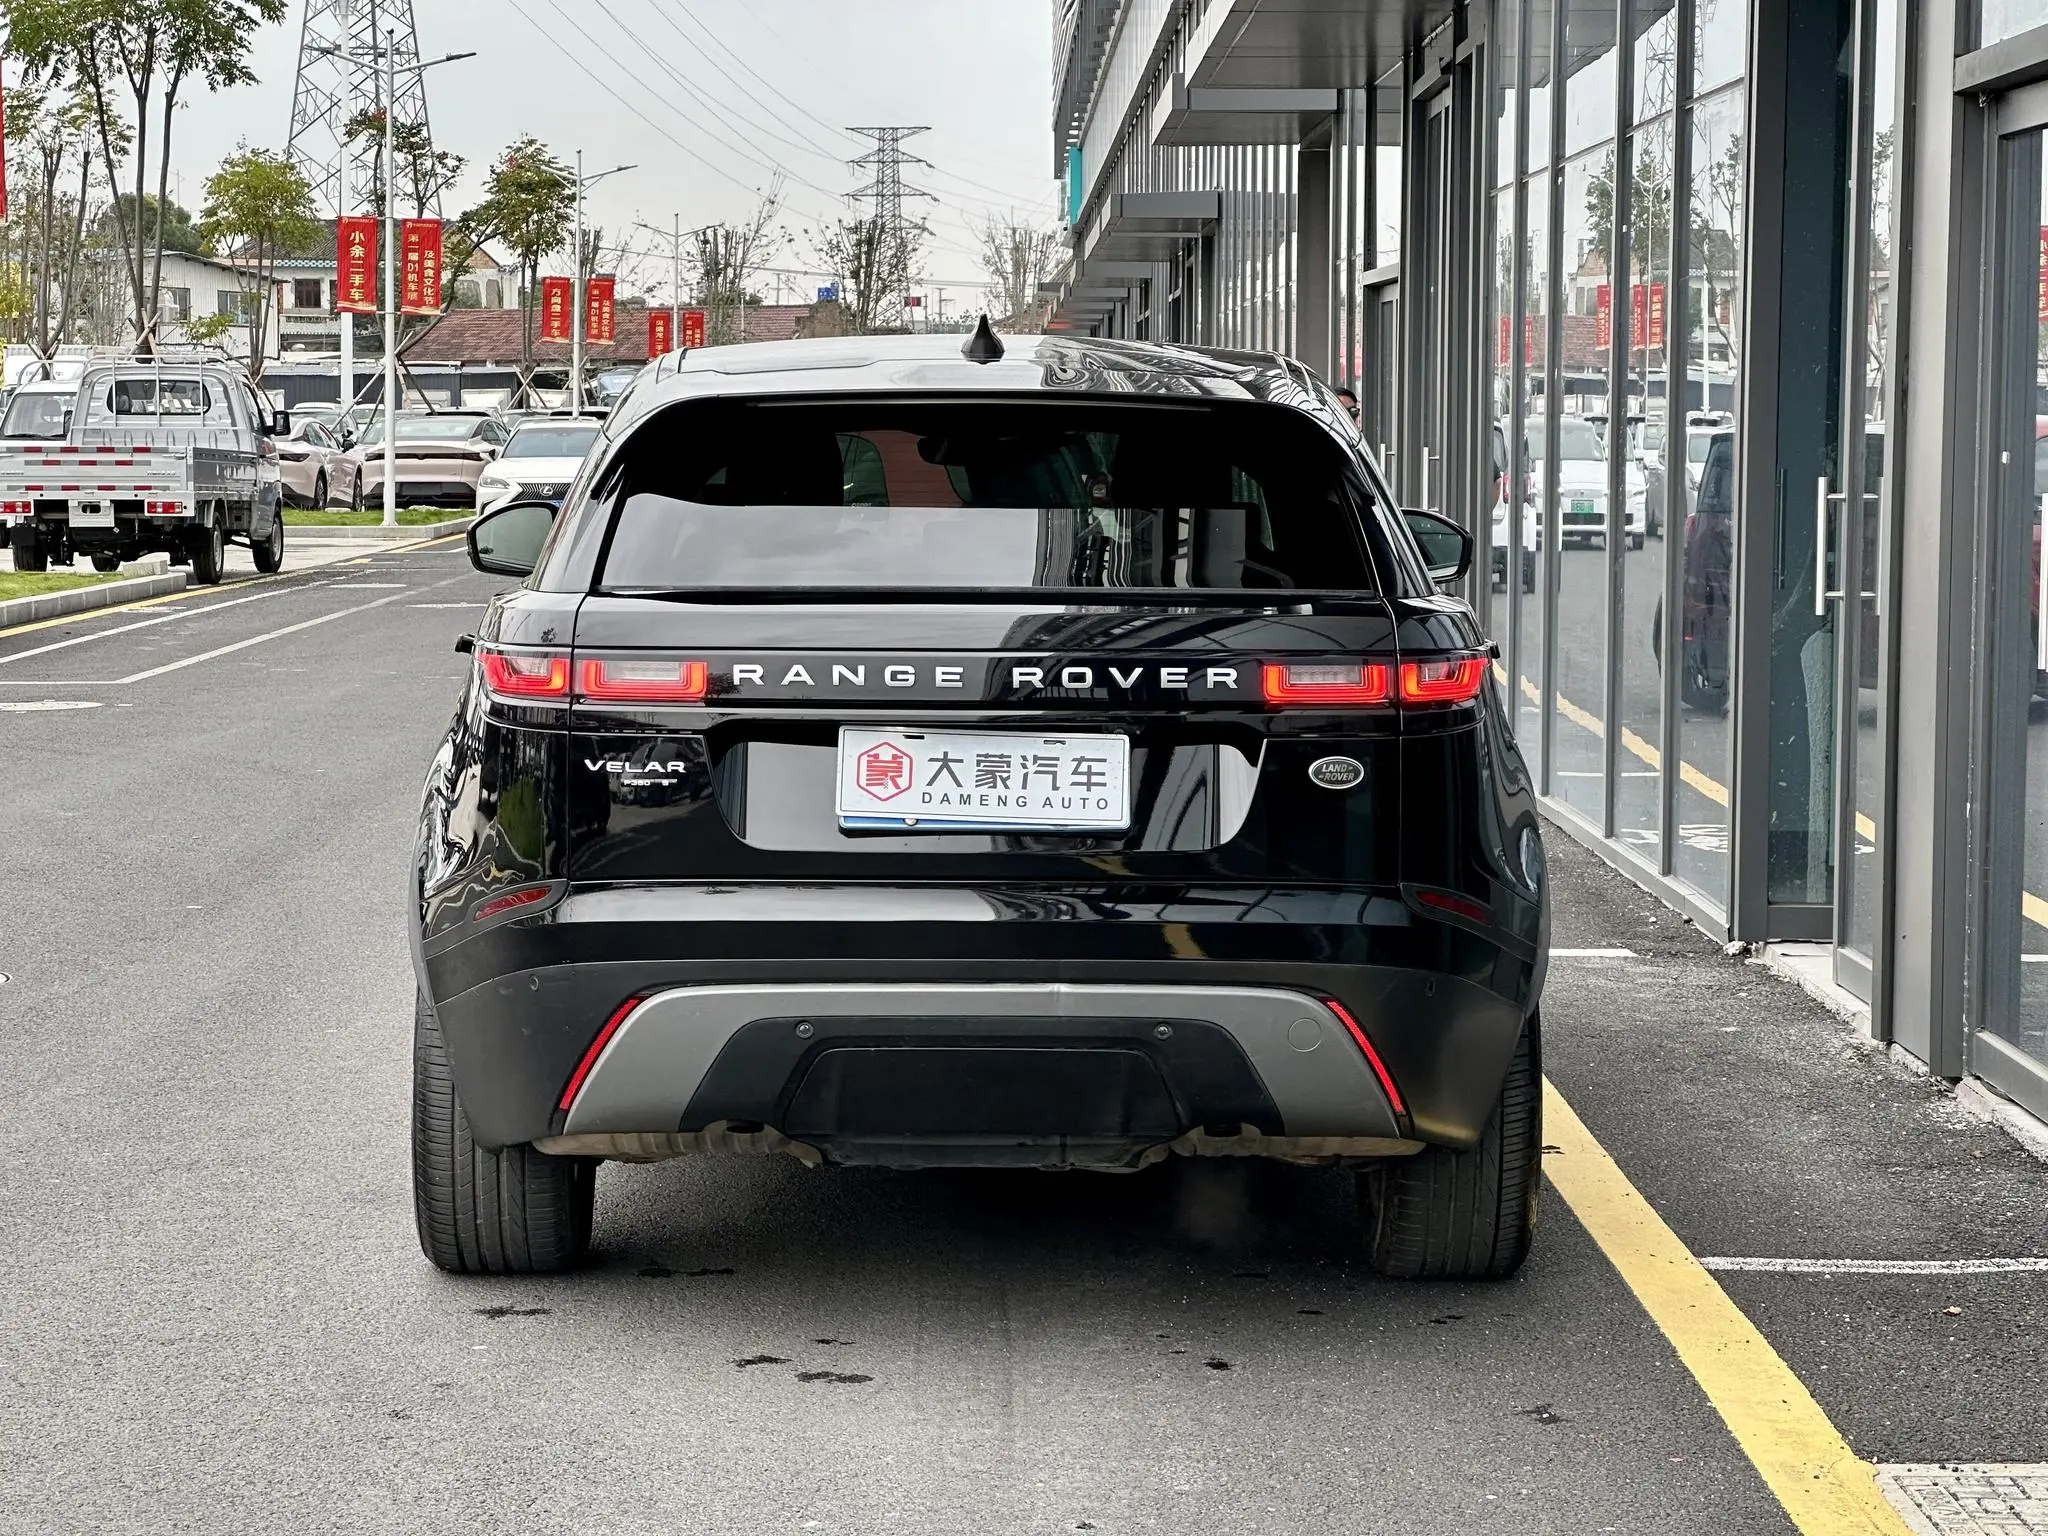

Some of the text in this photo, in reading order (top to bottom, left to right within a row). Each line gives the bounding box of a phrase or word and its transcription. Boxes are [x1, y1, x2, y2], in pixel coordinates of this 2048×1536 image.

[349, 230, 365, 301] 小余二手车
[732, 664, 1239, 689] RANGE ROVER
[583, 758, 687, 773] VELAR
[925, 750, 1109, 793] 大蒙汽车
[921, 790, 1109, 812] DAMENG AUTO
